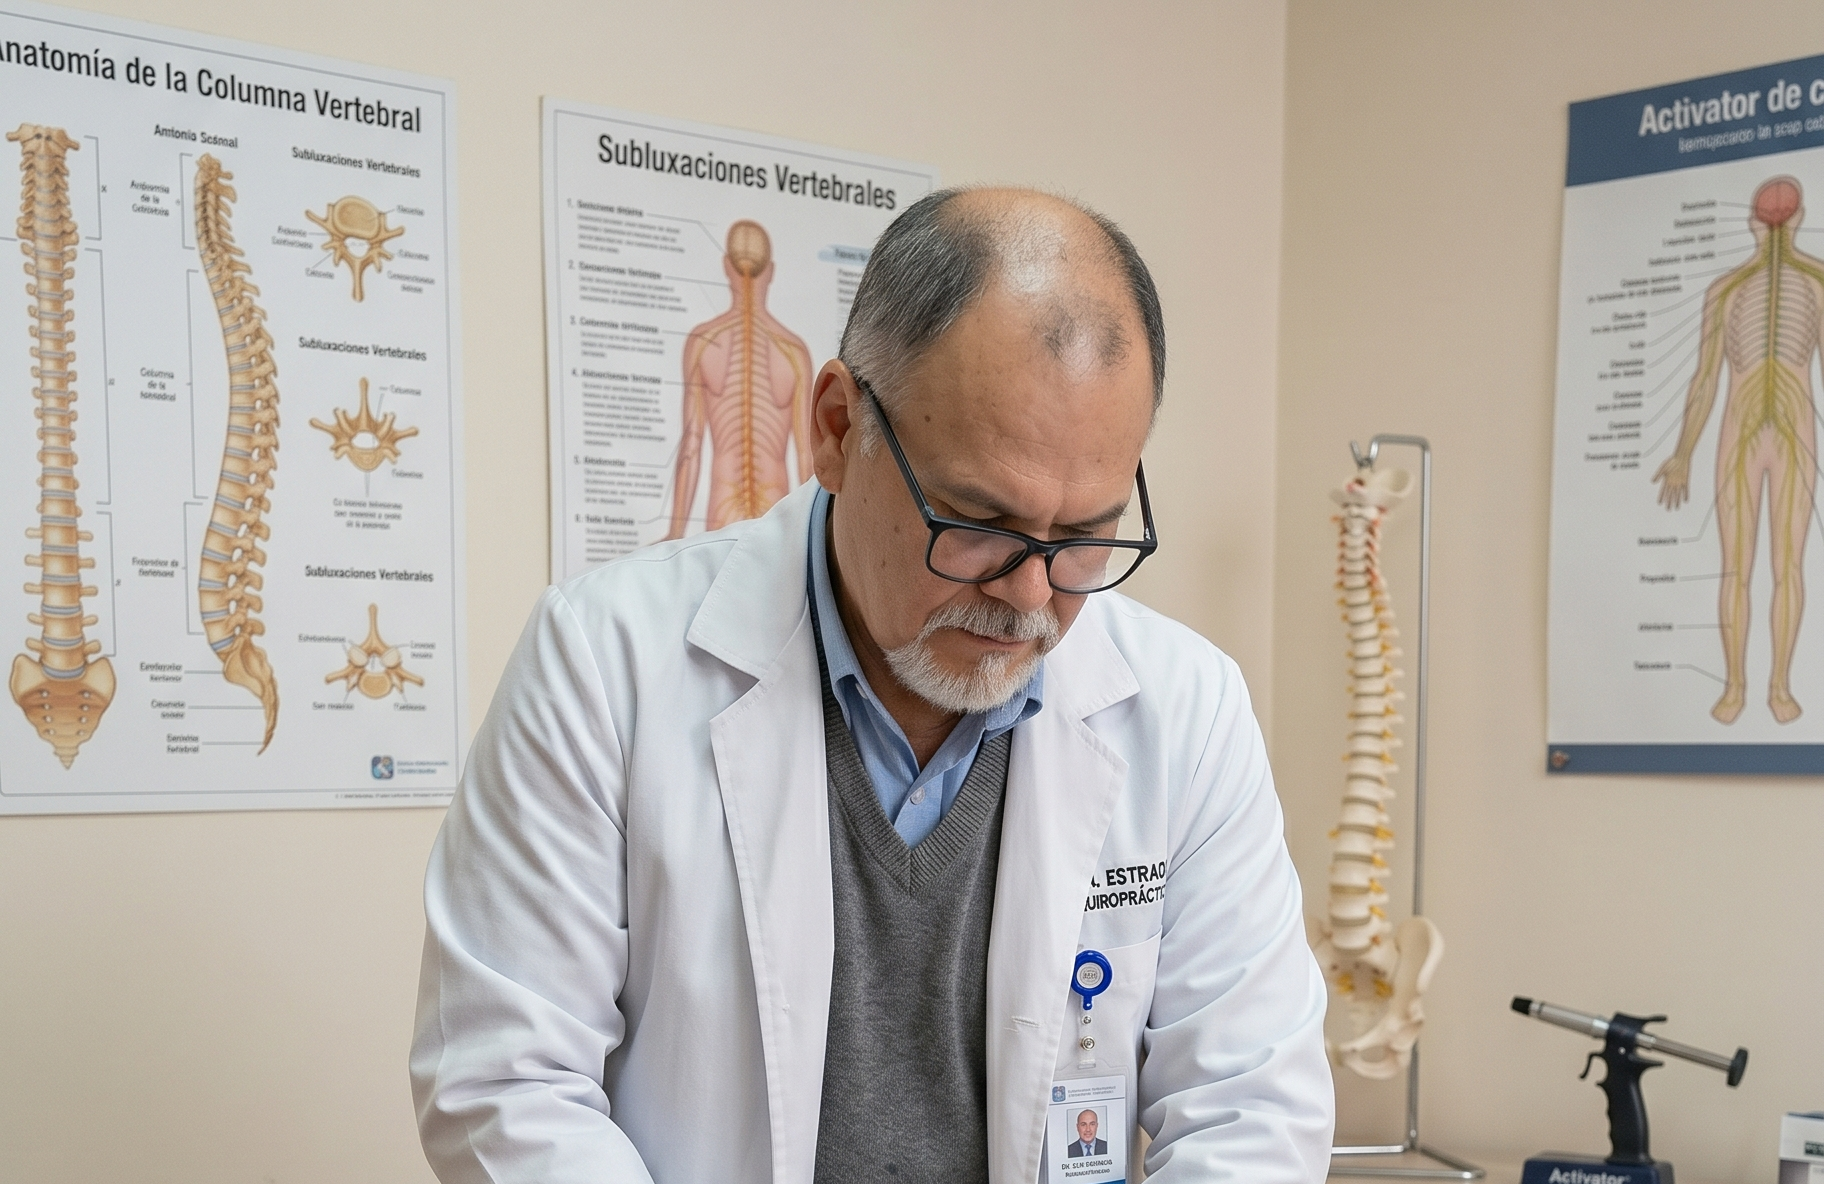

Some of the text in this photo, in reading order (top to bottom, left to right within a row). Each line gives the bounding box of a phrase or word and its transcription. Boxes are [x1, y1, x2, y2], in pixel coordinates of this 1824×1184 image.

[0, 41, 421, 133] natomía de la Columna Vertebral
[1638, 89, 1761, 137] Activator
[1767, 78, 1802, 113] de
[598, 133, 897, 211] Subluxaciones Vertebrales
